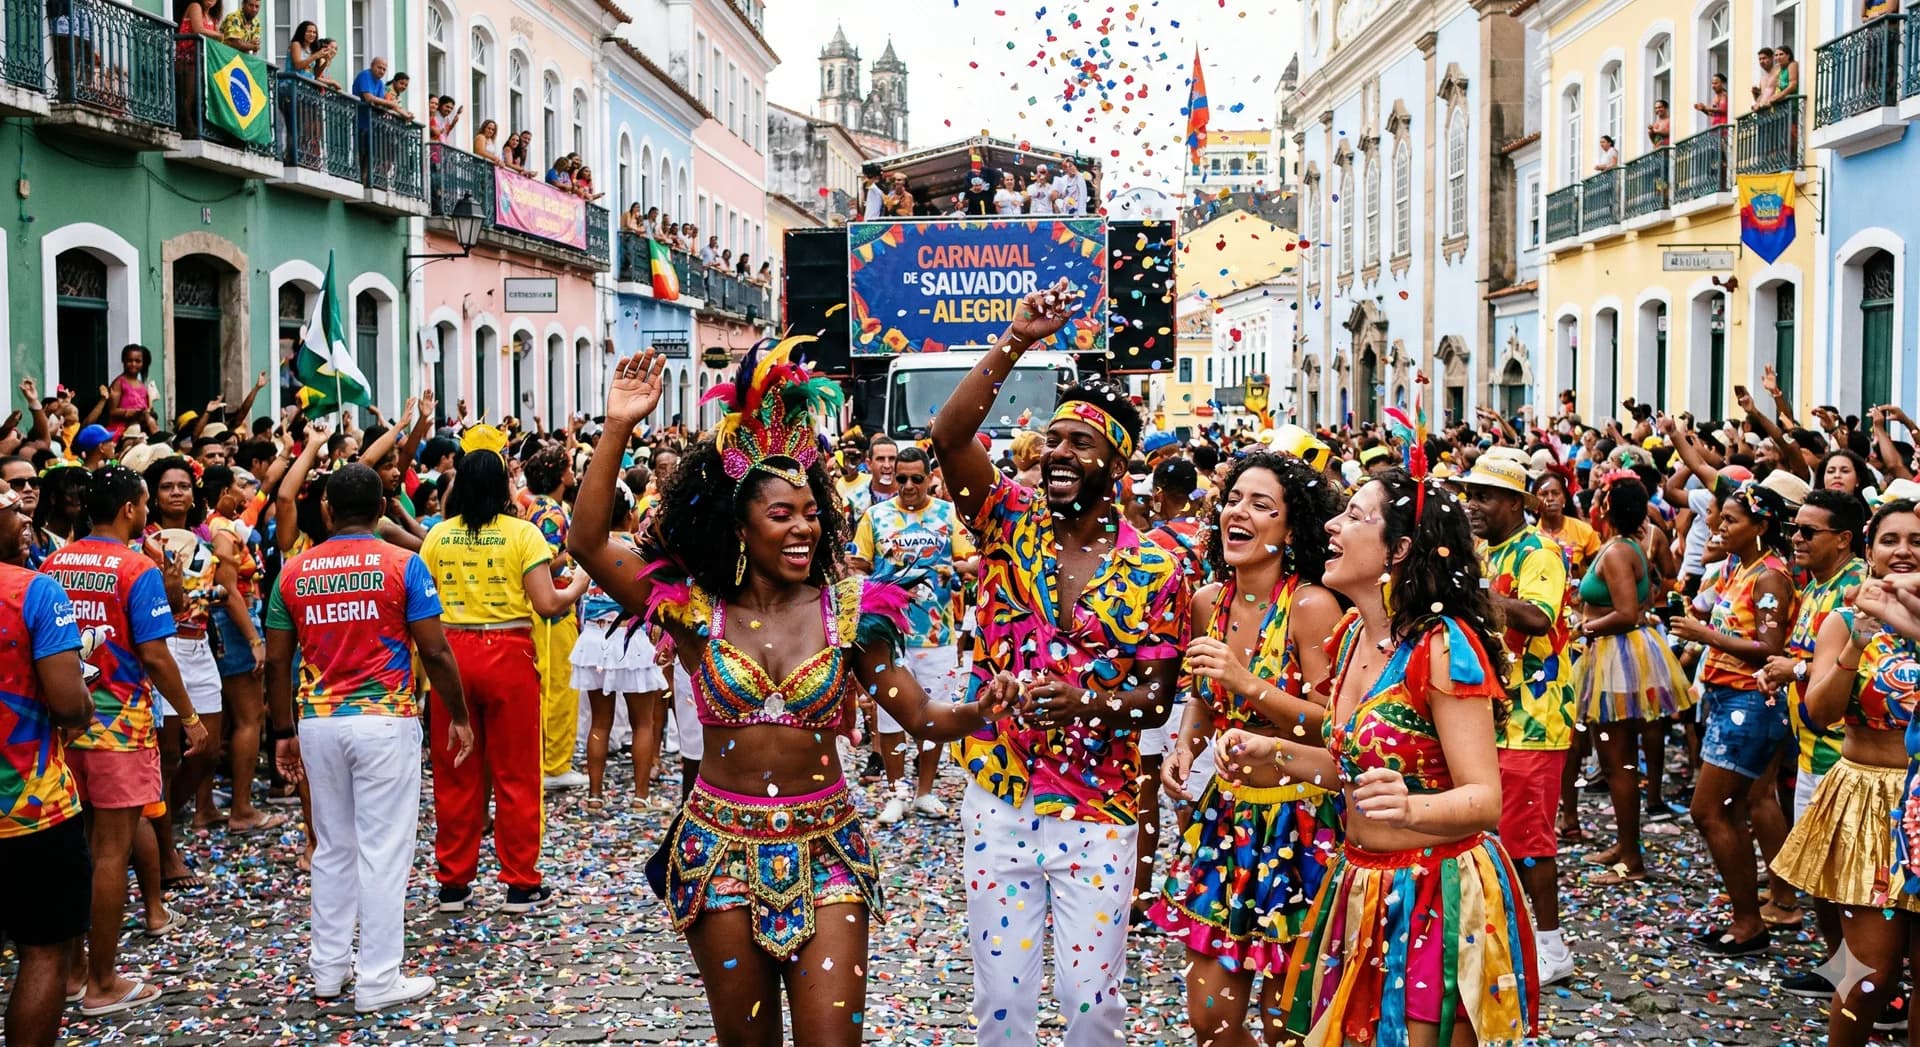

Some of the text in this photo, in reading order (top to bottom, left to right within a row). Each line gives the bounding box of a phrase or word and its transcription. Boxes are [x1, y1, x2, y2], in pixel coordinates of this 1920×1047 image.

[917, 244, 1035, 269] CARNAVAL
[903, 270, 1037, 296] DE SALVADOR
[53, 553, 121, 569] CARNAVAL DE
[302, 553, 381, 571] CARNAVAL DE
[296, 570, 384, 597] SALVADOR
[69, 600, 107, 621] GRIA
[305, 600, 379, 625] ALEGRIA
